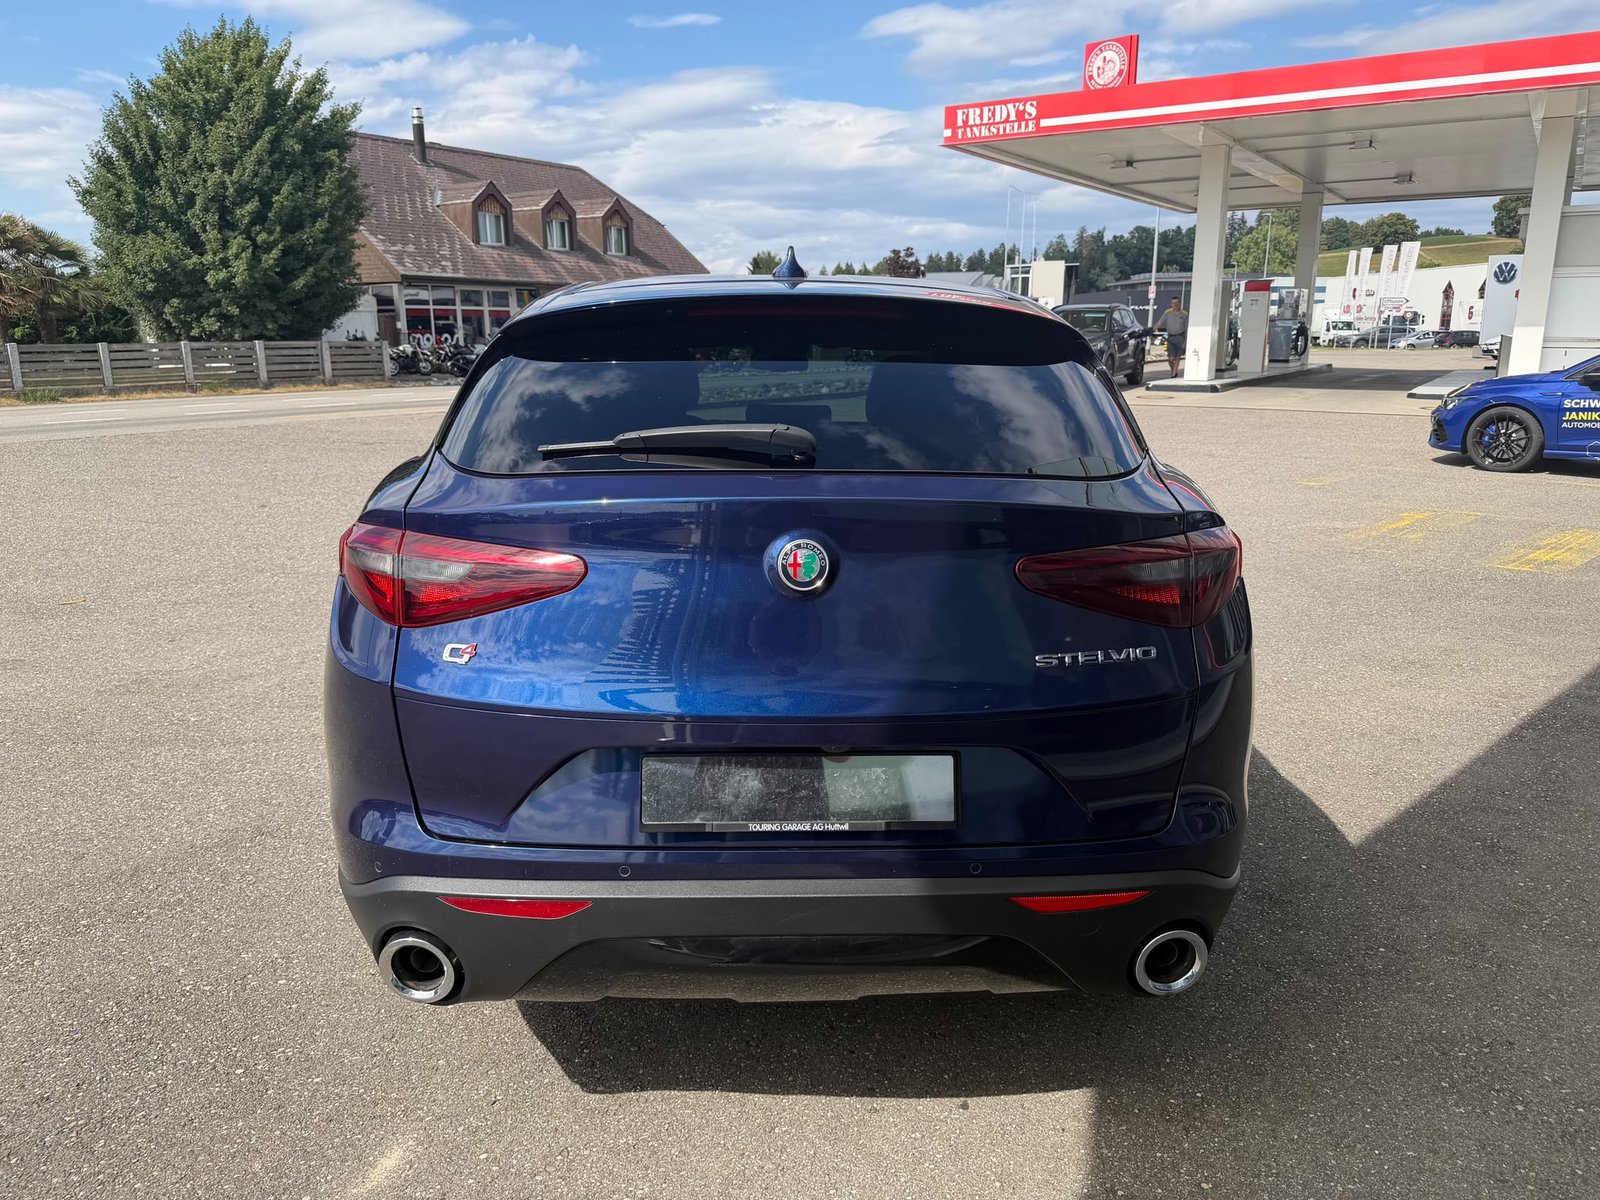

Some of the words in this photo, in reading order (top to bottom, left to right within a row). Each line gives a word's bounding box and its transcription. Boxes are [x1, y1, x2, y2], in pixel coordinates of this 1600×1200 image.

[956, 100, 1037, 127] FREDY'S
[956, 120, 1036, 140] TANKSTELLE
[1562, 411, 1600, 421] JANIK
[800, 542, 826, 567] ROMEO
[1035, 645, 1157, 668] STELVIO
[748, 823, 781, 832] TOURING
[781, 823, 812, 831] GARAGE
[812, 823, 824, 831] AG
[824, 822, 849, 831] Huttwil
